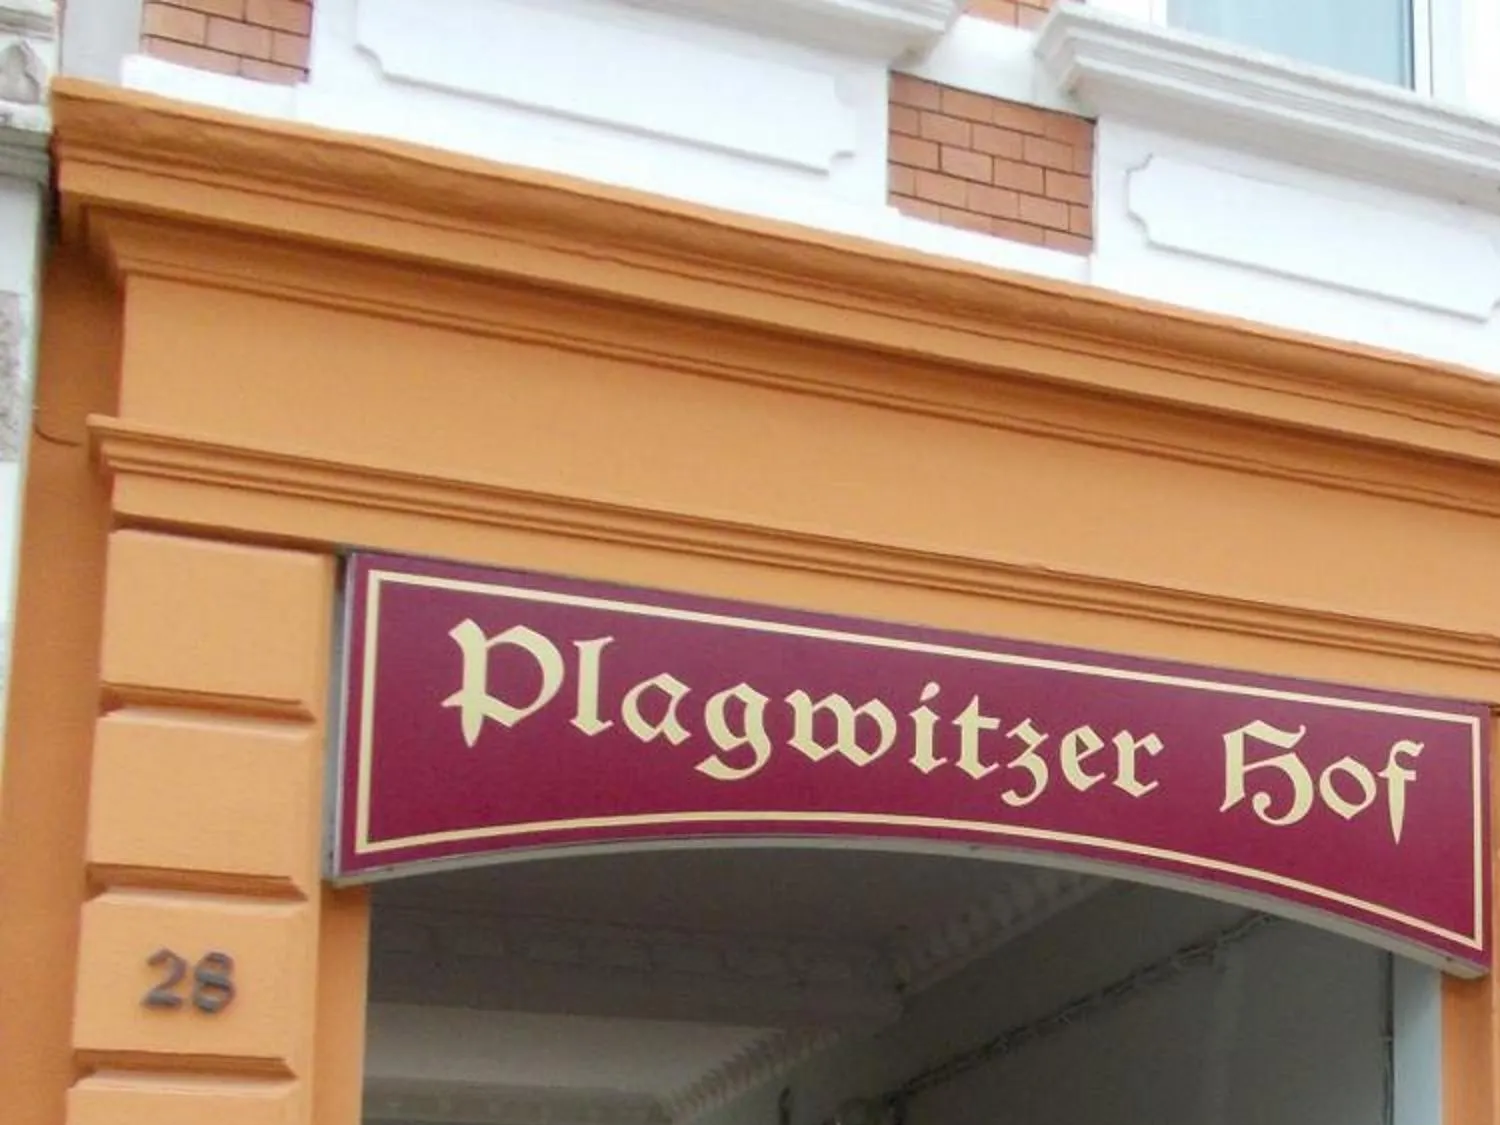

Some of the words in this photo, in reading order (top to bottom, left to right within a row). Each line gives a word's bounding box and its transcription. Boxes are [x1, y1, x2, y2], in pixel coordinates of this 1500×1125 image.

[442, 618, 1164, 806] Plagwitzer
[1220, 719, 1425, 843] Hof
[141, 948, 236, 1014] 28
